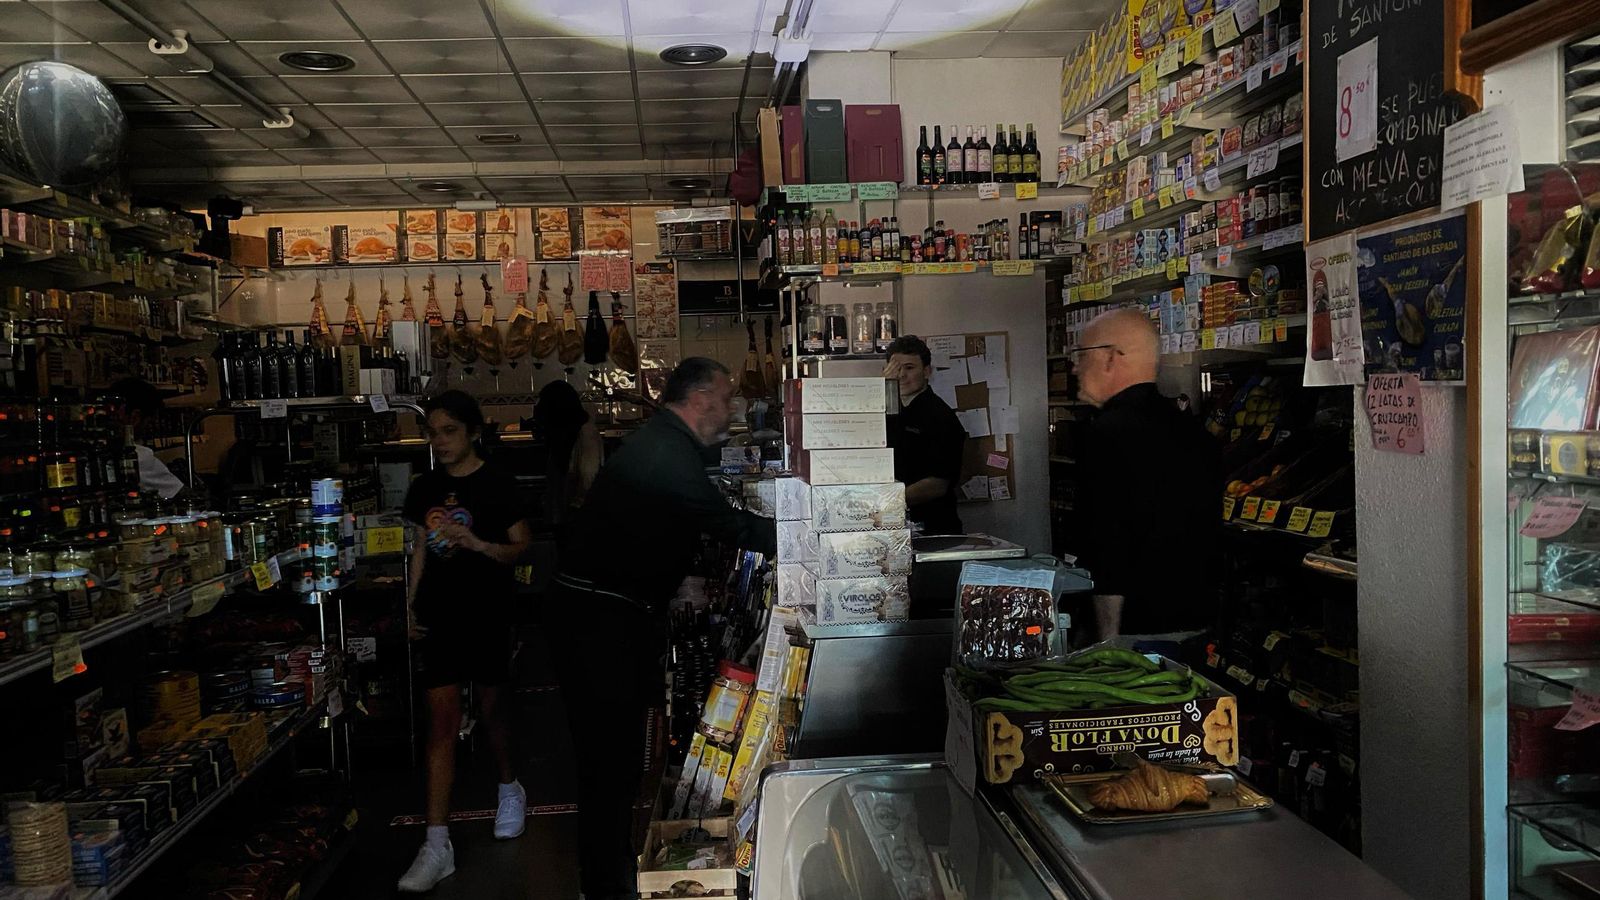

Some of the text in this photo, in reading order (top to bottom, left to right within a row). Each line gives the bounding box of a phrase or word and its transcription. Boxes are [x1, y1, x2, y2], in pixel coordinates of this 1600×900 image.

[1322, 25, 1338, 49] DE
[1381, 93, 1399, 119] SE
[1321, 149, 1439, 192] CON MELVA EN
[1395, 228, 1442, 246] PRODUCTOS DE
[1383, 240, 1458, 264] SANTIAGO DE LA ESPADA
[1373, 376, 1404, 390] OFERTA
[1378, 394, 1403, 408] LATAS
[1371, 412, 1418, 427] CRUZCAMPO
[842, 593, 880, 603] VIROLOS
[1049, 714, 1181, 729] PRODUCTOS TRADICIONALES
[1050, 730, 1111, 752] FLOR
[1100, 744, 1132, 753] HORNO
